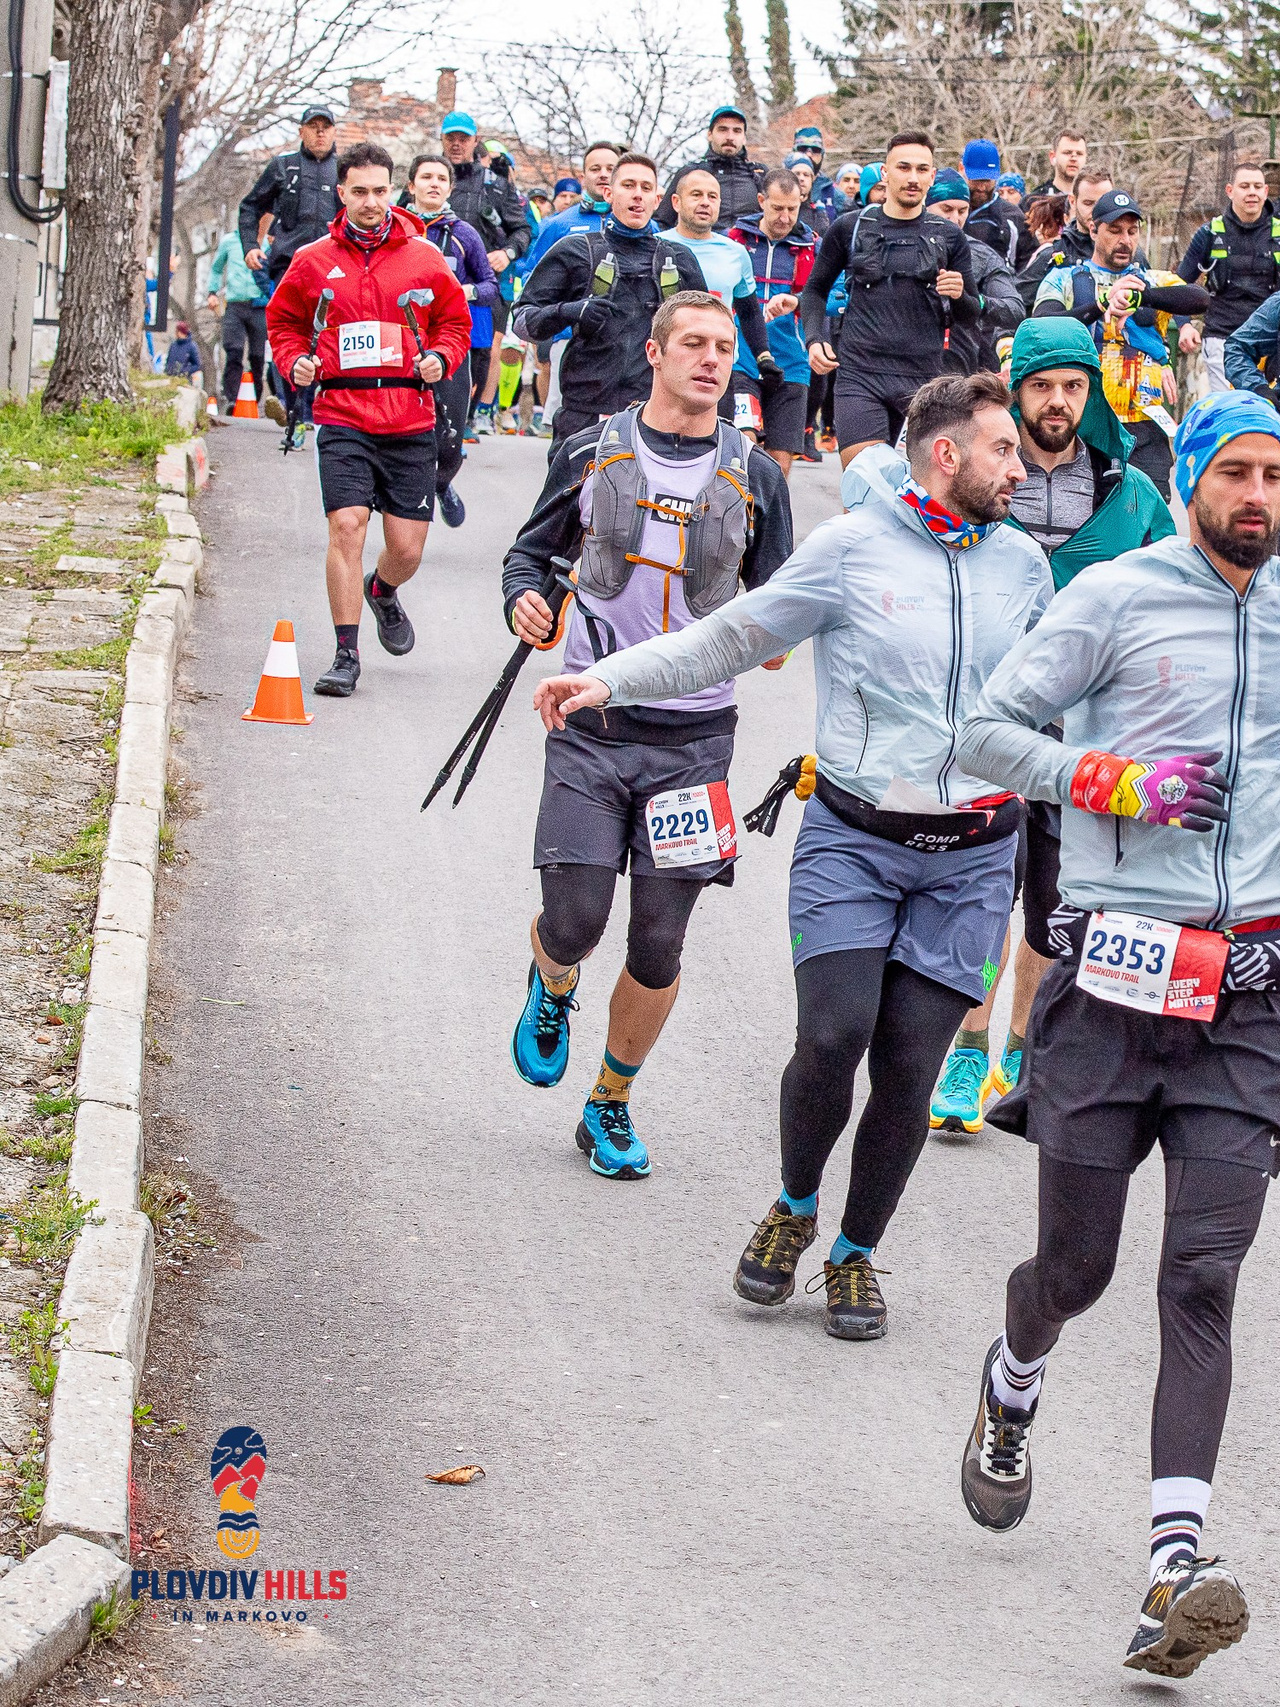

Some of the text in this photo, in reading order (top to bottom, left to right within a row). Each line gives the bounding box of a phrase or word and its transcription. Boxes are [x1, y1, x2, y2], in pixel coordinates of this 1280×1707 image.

[343, 335, 375, 351] 2150
[678, 792, 692, 802] 22K
[651, 809, 709, 841] 2229
[914, 833, 960, 844] COMP
[904, 840, 948, 852] RESS
[1136, 920, 1154, 931] 22K
[1087, 930, 1166, 975] 2353
[1084, 964, 1140, 984] MARKOVO TRAIL
[1168, 978, 1200, 990] EVERY
[1167, 988, 1194, 1000] STEP
[1168, 994, 1215, 1010] MATTERS
